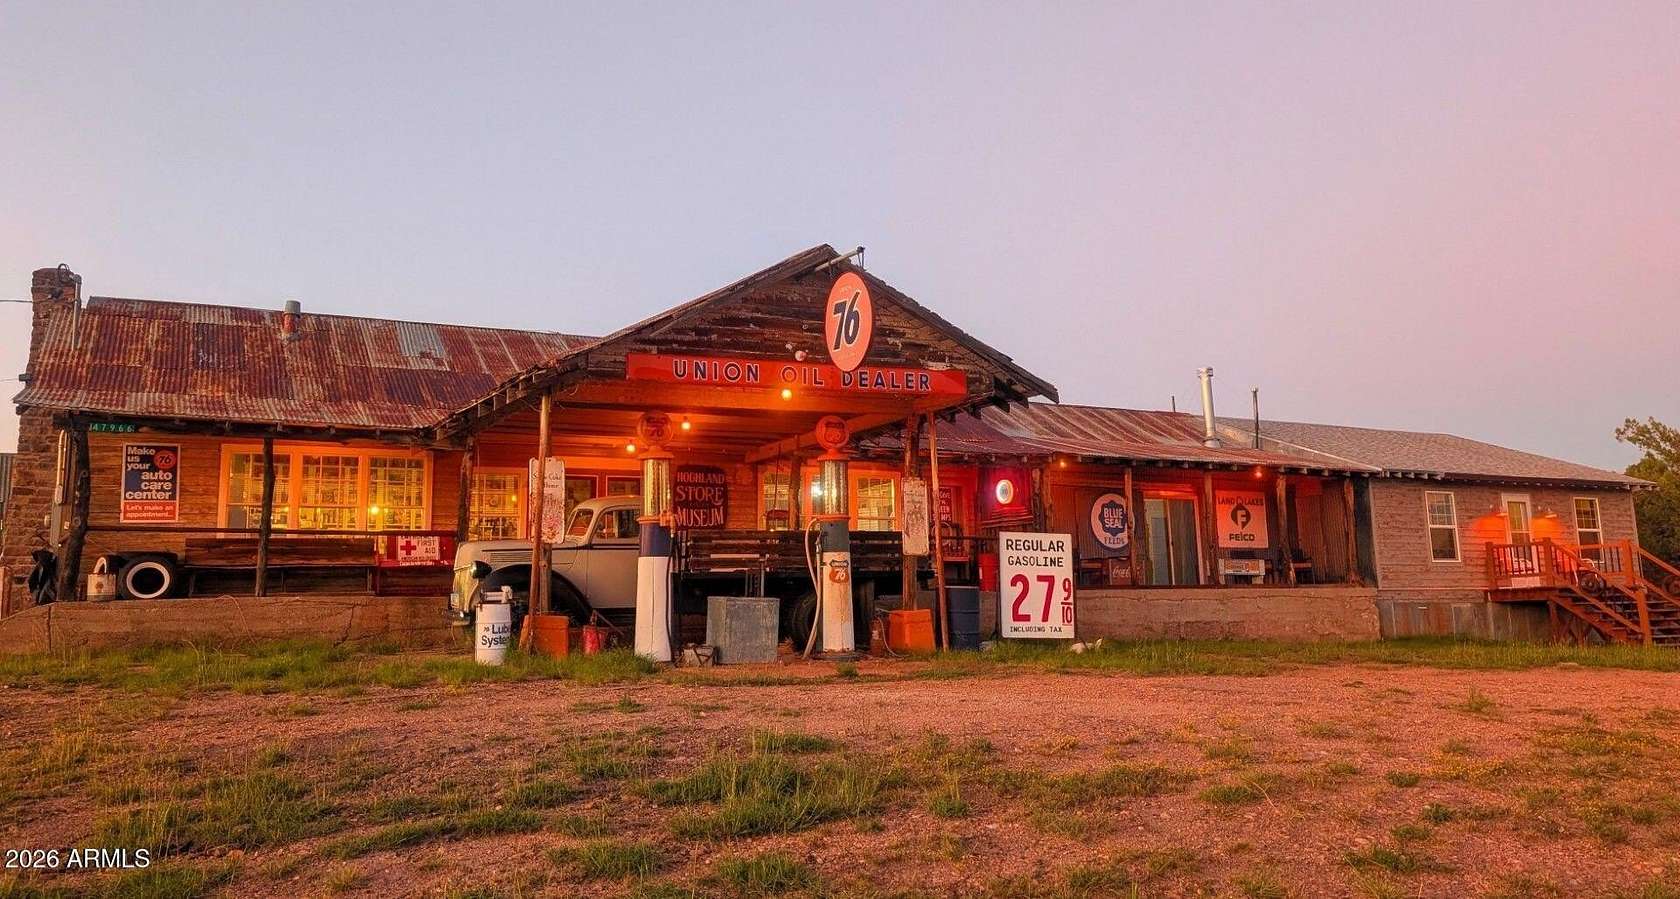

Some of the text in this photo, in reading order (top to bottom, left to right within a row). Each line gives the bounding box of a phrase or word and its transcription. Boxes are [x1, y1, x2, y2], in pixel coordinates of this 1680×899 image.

[832, 290, 861, 352] 76
[673, 359, 932, 391] UNION OIL DEALER
[127, 446, 156, 455] Make
[159, 455, 173, 463] 76
[126, 463, 151, 471] your
[141, 470, 172, 480] auto
[141, 481, 172, 490] care
[125, 490, 172, 500] center
[675, 485, 724, 506] STORE
[1218, 496, 1235, 505] LAND
[1245, 496, 1265, 506] LAKES
[675, 505, 724, 527] MUSEUM
[1103, 507, 1124, 519] BLUE
[1104, 519, 1124, 529] SEAL
[1006, 539, 1065, 552] REGULAR
[1008, 556, 1064, 567] GASOLINE
[1010, 574, 1055, 622] 27
[492, 624, 511, 634] Lub
